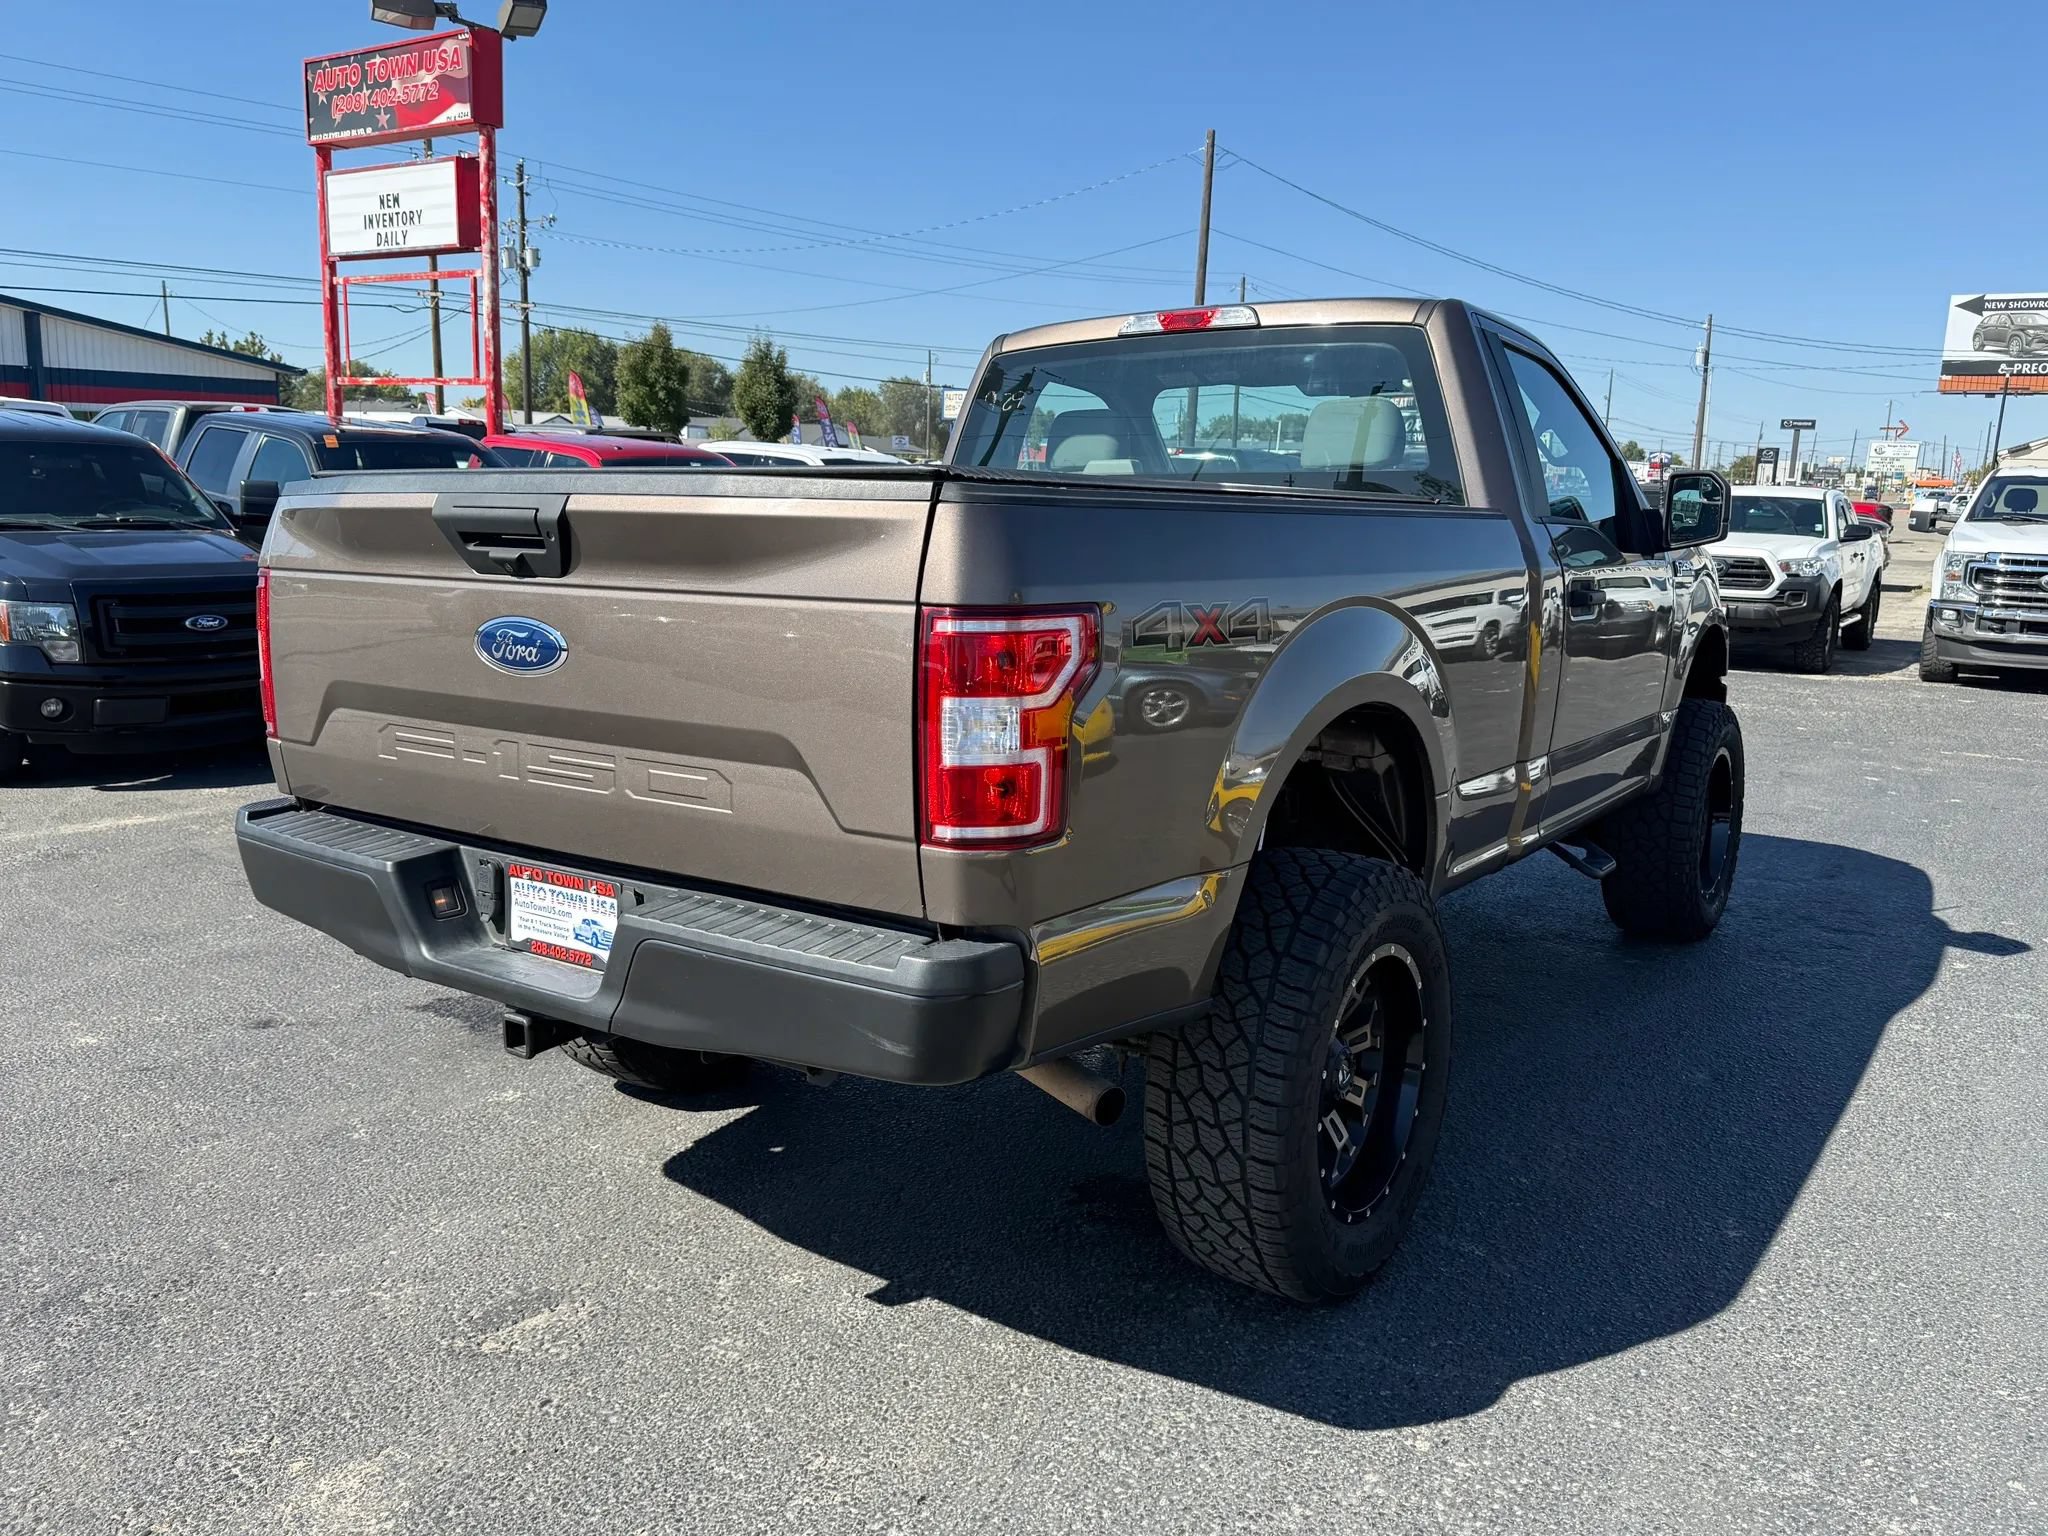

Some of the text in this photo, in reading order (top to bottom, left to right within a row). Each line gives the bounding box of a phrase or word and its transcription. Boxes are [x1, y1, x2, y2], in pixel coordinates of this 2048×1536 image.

[313, 45, 462, 93] AUTO TOWN USA
[331, 80, 439, 119] (208) 402-5772
[379, 193, 400, 210] NEW
[364, 209, 422, 230] INVENTORY
[377, 230, 408, 247] DAILY
[197, 617, 220, 628] Ford
[492, 628, 541, 663] Ford
[378, 723, 733, 814] F-150
[508, 864, 615, 897] AUTO TOWN USA
[514, 898, 573, 919] AutoTownUS.com
[532, 926, 552, 935] Treasure
[539, 920, 552, 928] Truck
[553, 923, 570, 932] Source
